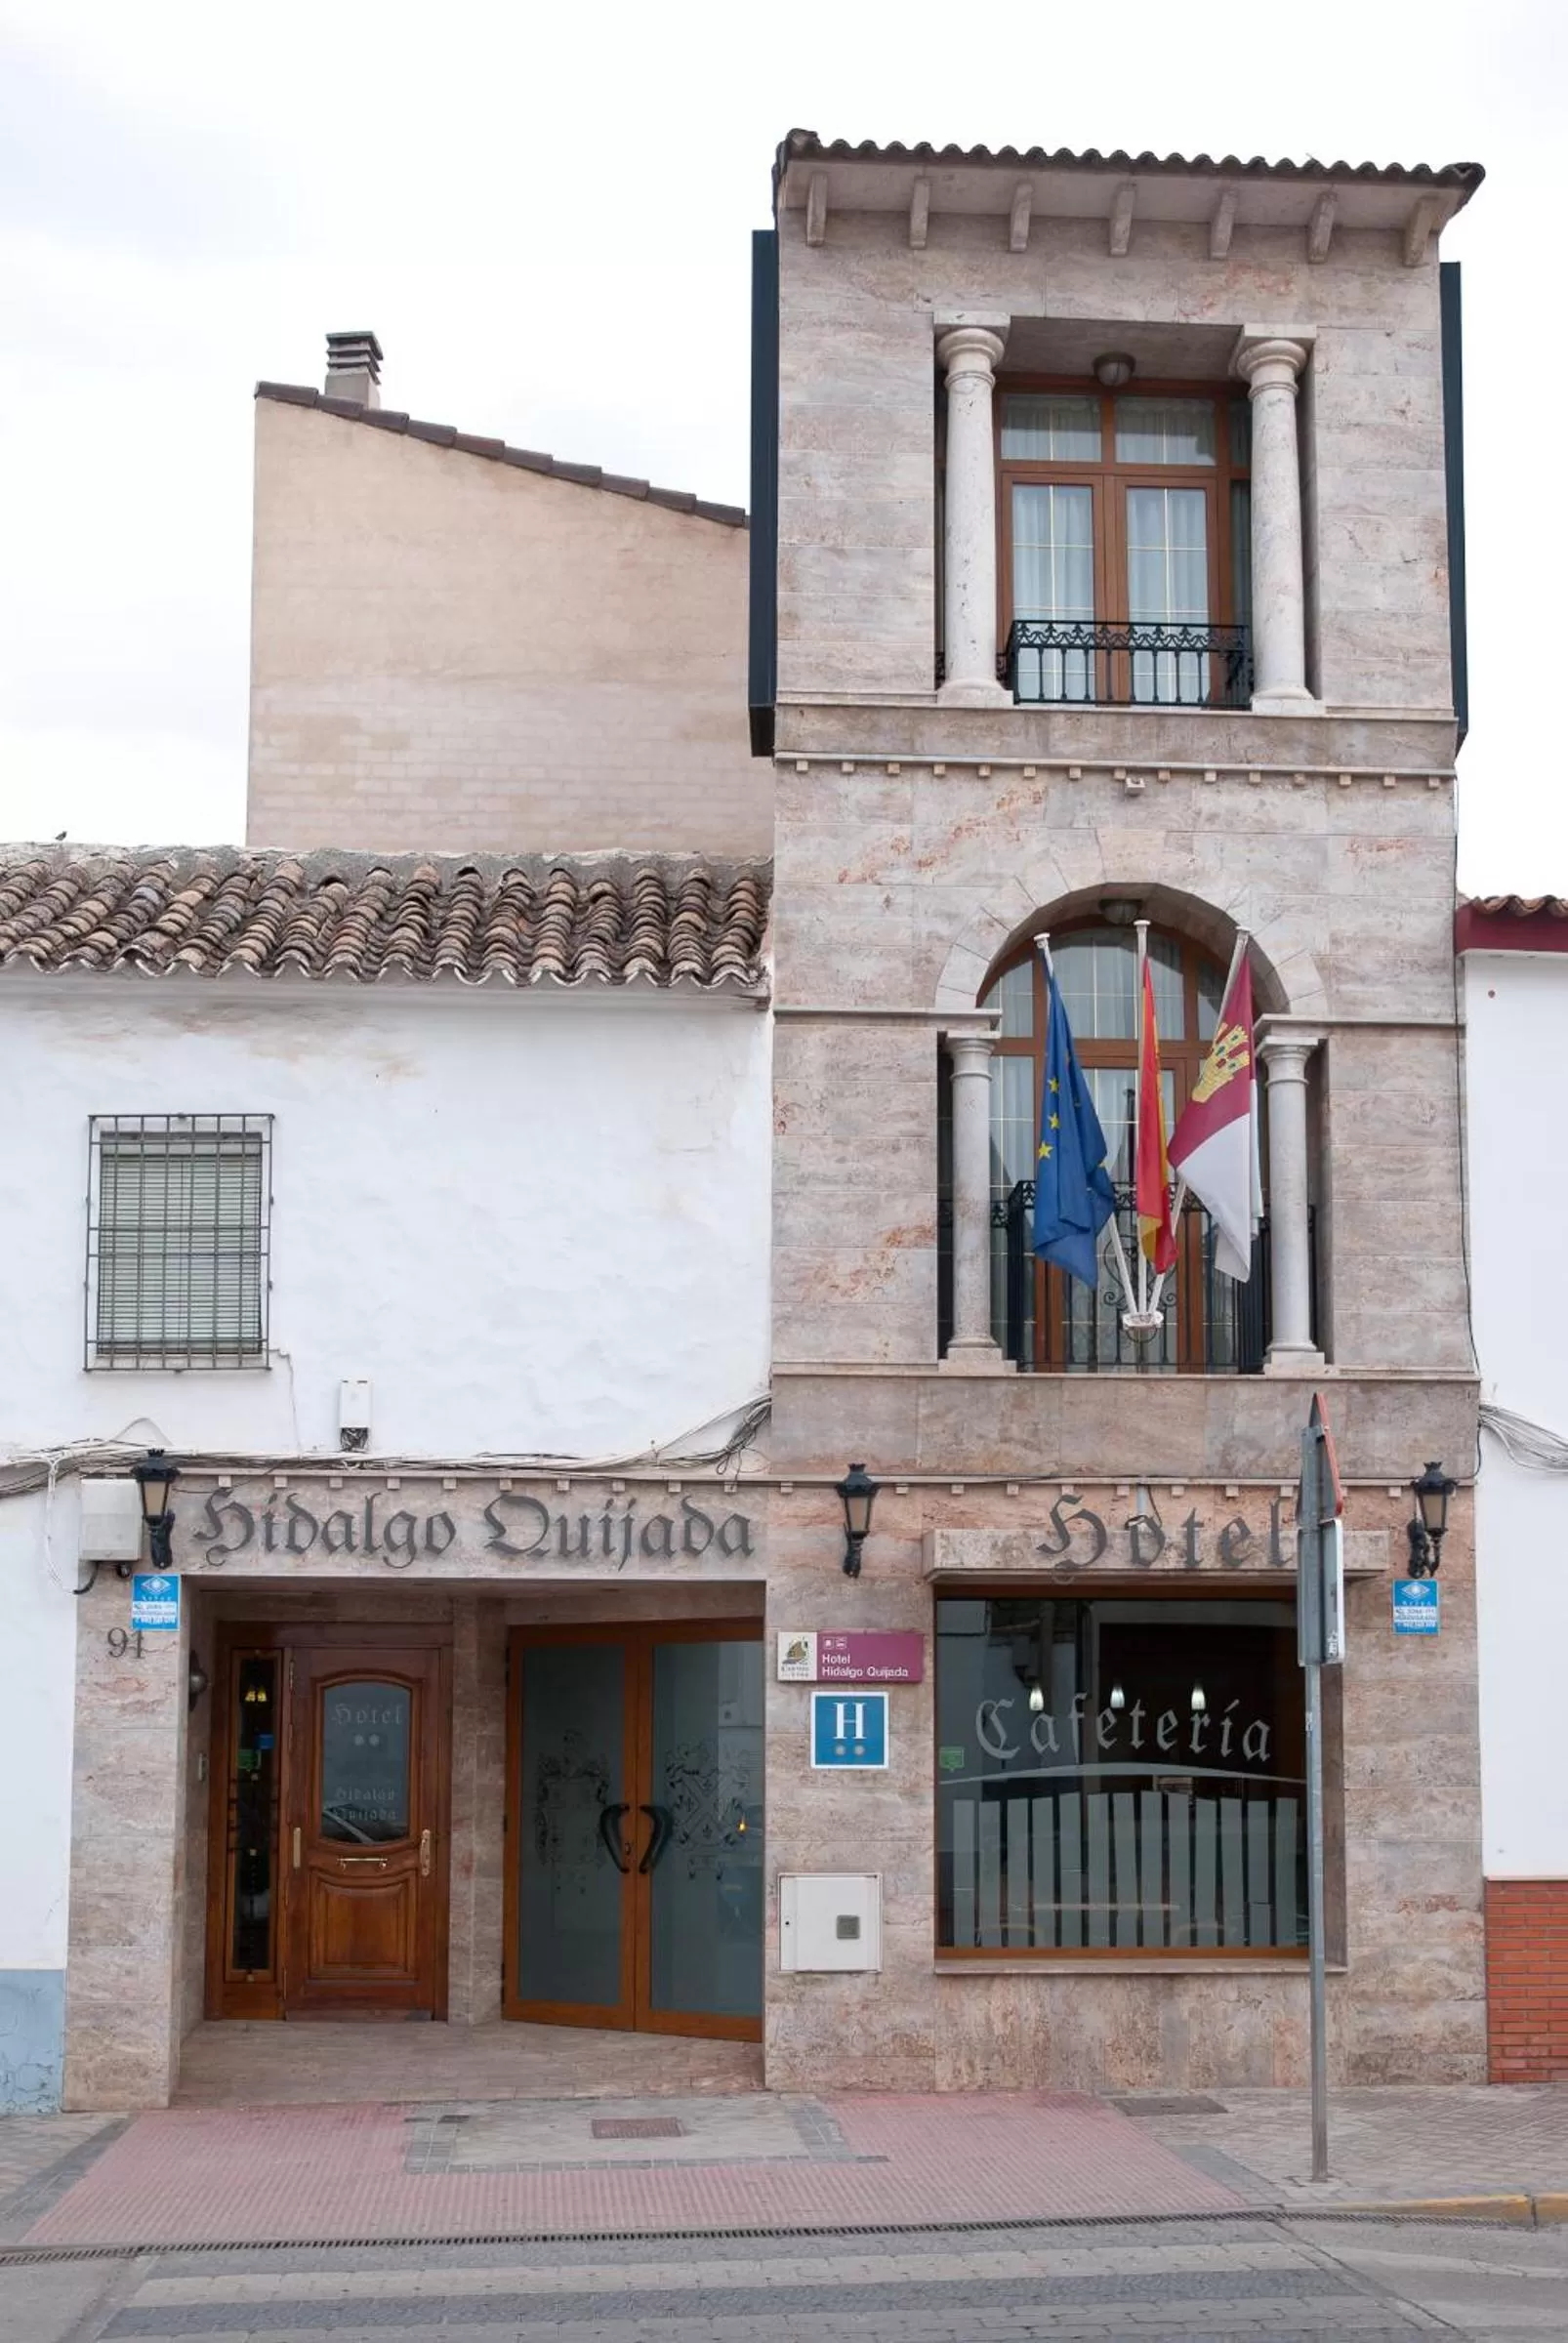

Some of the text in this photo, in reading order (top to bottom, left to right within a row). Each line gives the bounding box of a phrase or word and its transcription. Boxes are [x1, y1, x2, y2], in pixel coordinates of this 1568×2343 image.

[195, 1488, 755, 1572] Hidalgo Quijada
[1036, 1493, 1297, 1584] Hotel
[107, 1627, 146, 1659] 91
[821, 1654, 851, 1665] Hotel
[821, 1666, 864, 1678] Hidalgo
[866, 1665, 909, 1678] Quijada
[832, 1702, 867, 1740] H
[975, 1691, 1271, 1765] Cafetería
